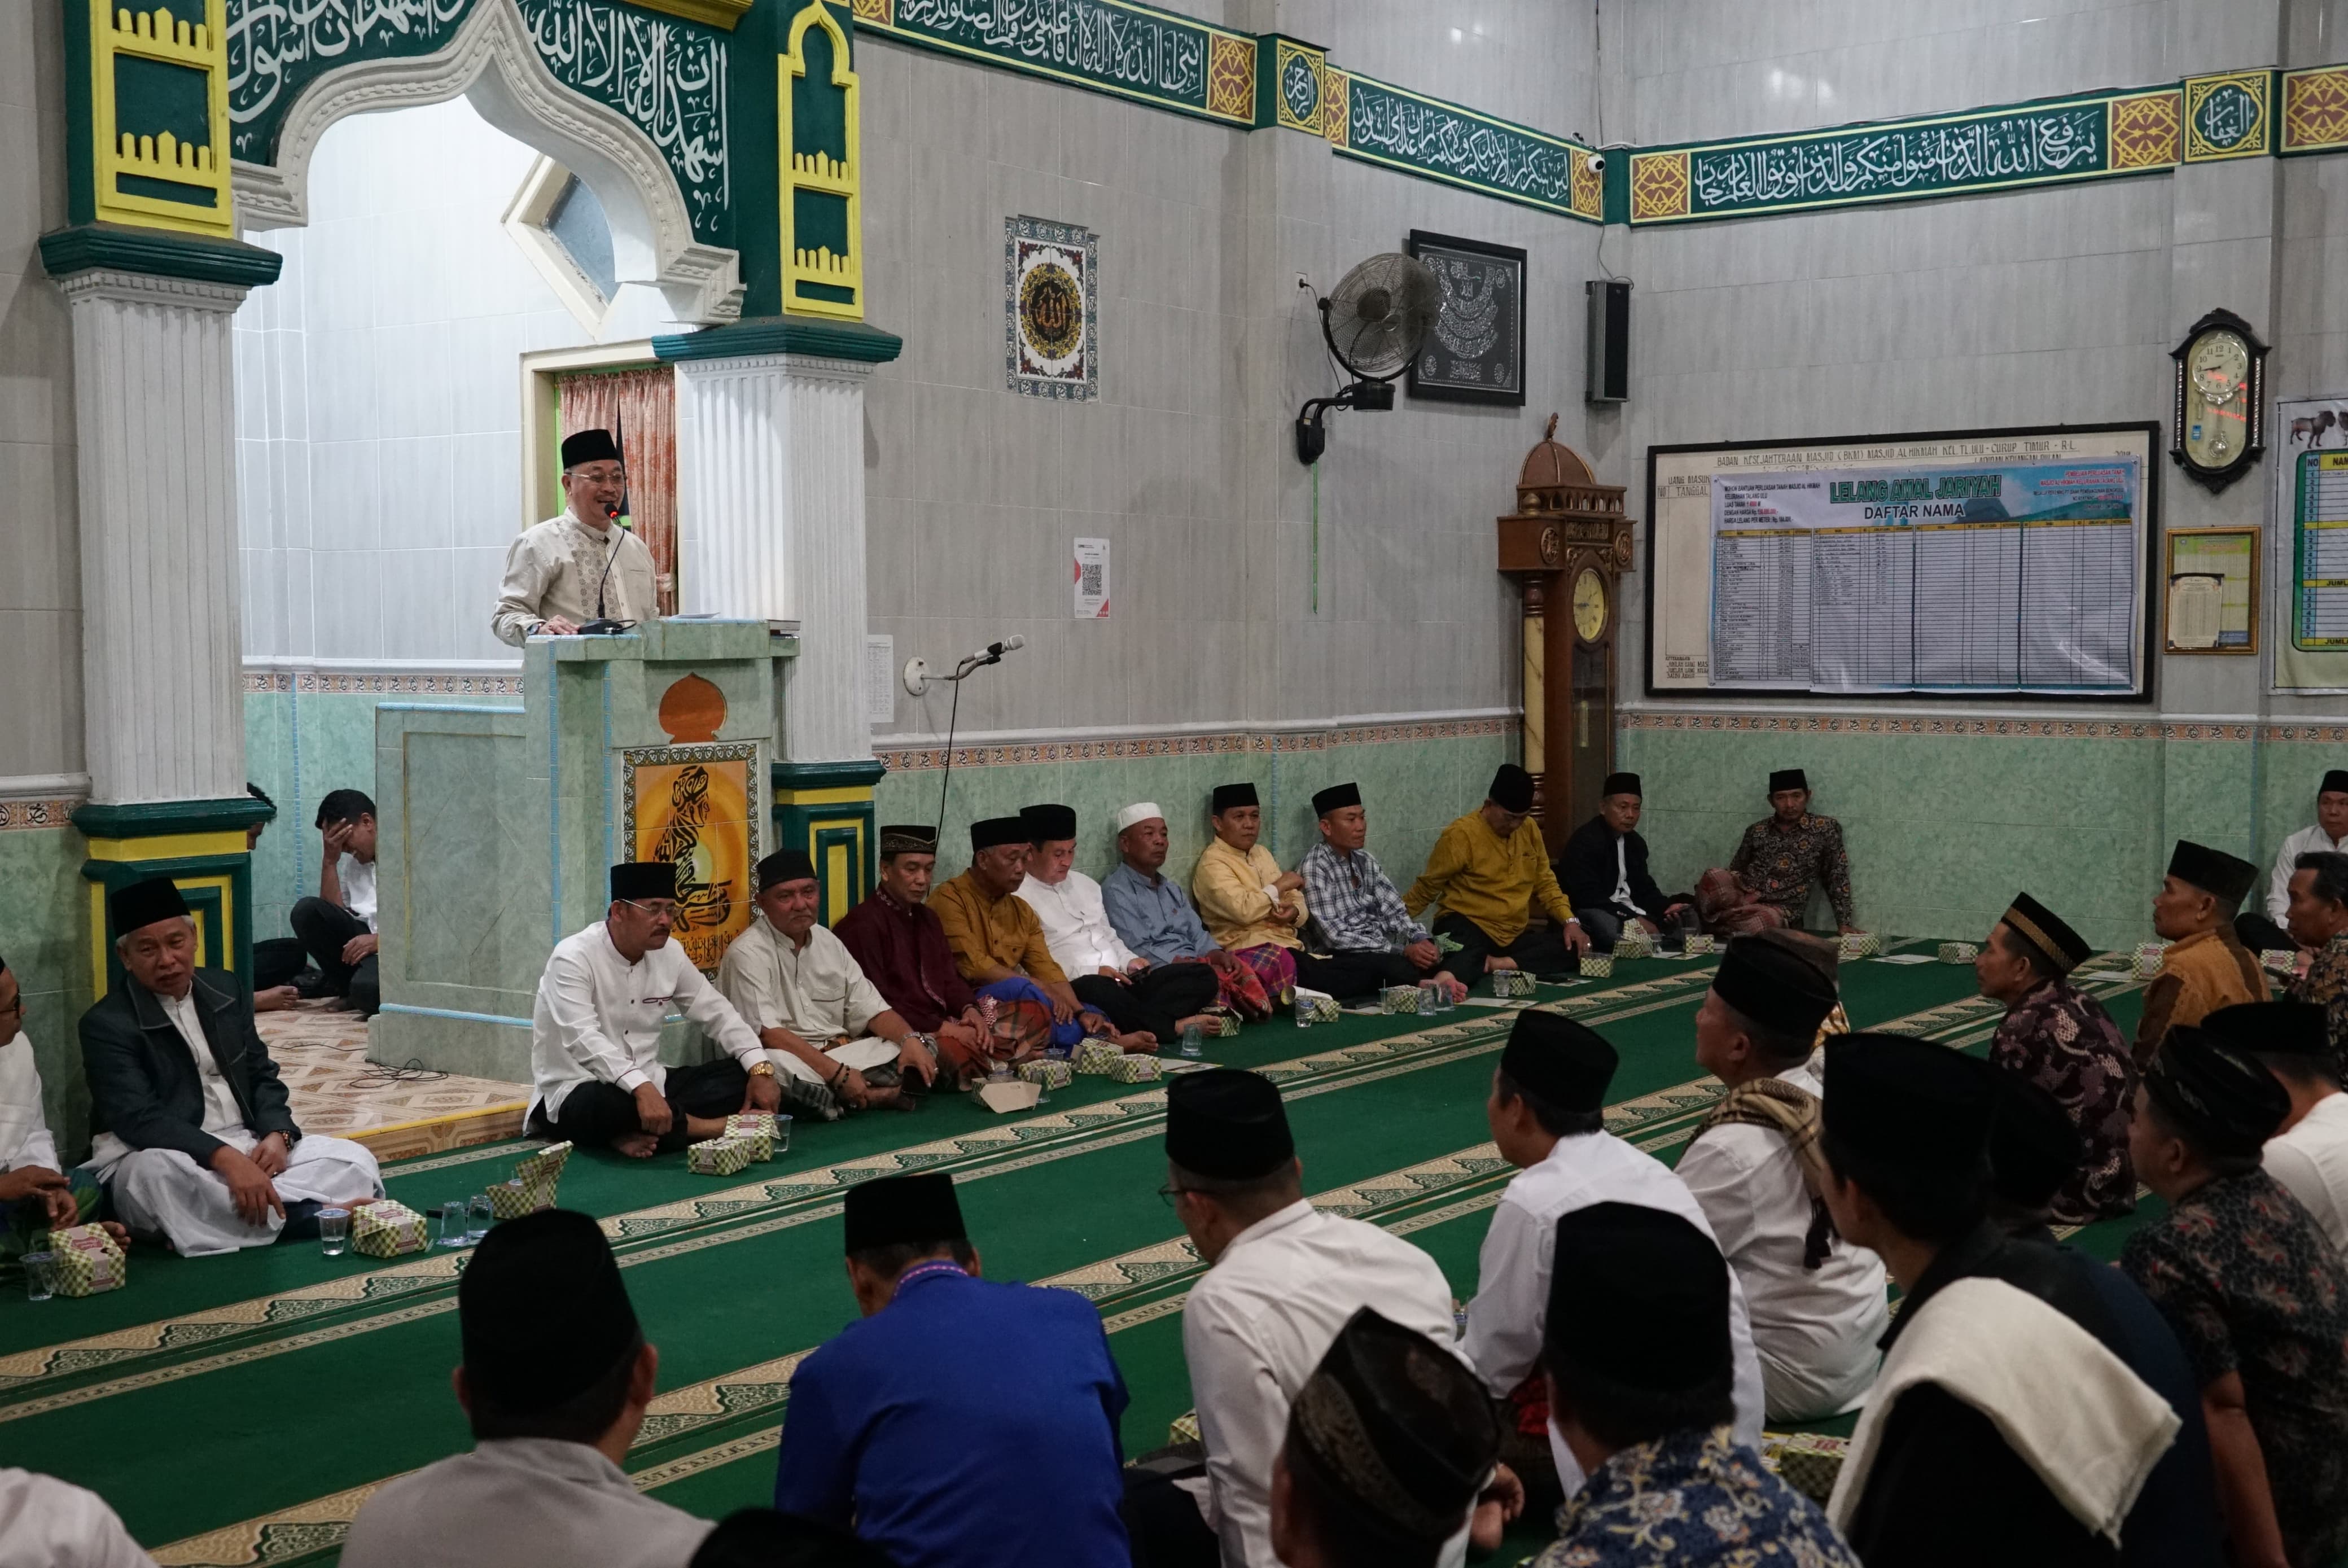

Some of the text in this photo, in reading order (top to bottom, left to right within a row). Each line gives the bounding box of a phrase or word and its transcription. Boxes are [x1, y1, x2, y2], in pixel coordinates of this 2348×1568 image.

[1718, 456, 1738, 466] BADAN
[1807, 452, 1833, 462] MASJID
[1868, 448, 1894, 459] MASJID
[1896, 448, 1907, 457] AL
[1909, 446, 1937, 457] HIKMAH
[1991, 443, 2017, 453] CURUP
[2024, 441, 2049, 452] TIMUR
[2307, 457, 2319, 467] NO
[1675, 486, 1708, 496] TANGGAL
[1830, 475, 2002, 503] LELANG AMAL JARIYAH
[1864, 503, 1964, 519] DAFTAR NAMA
